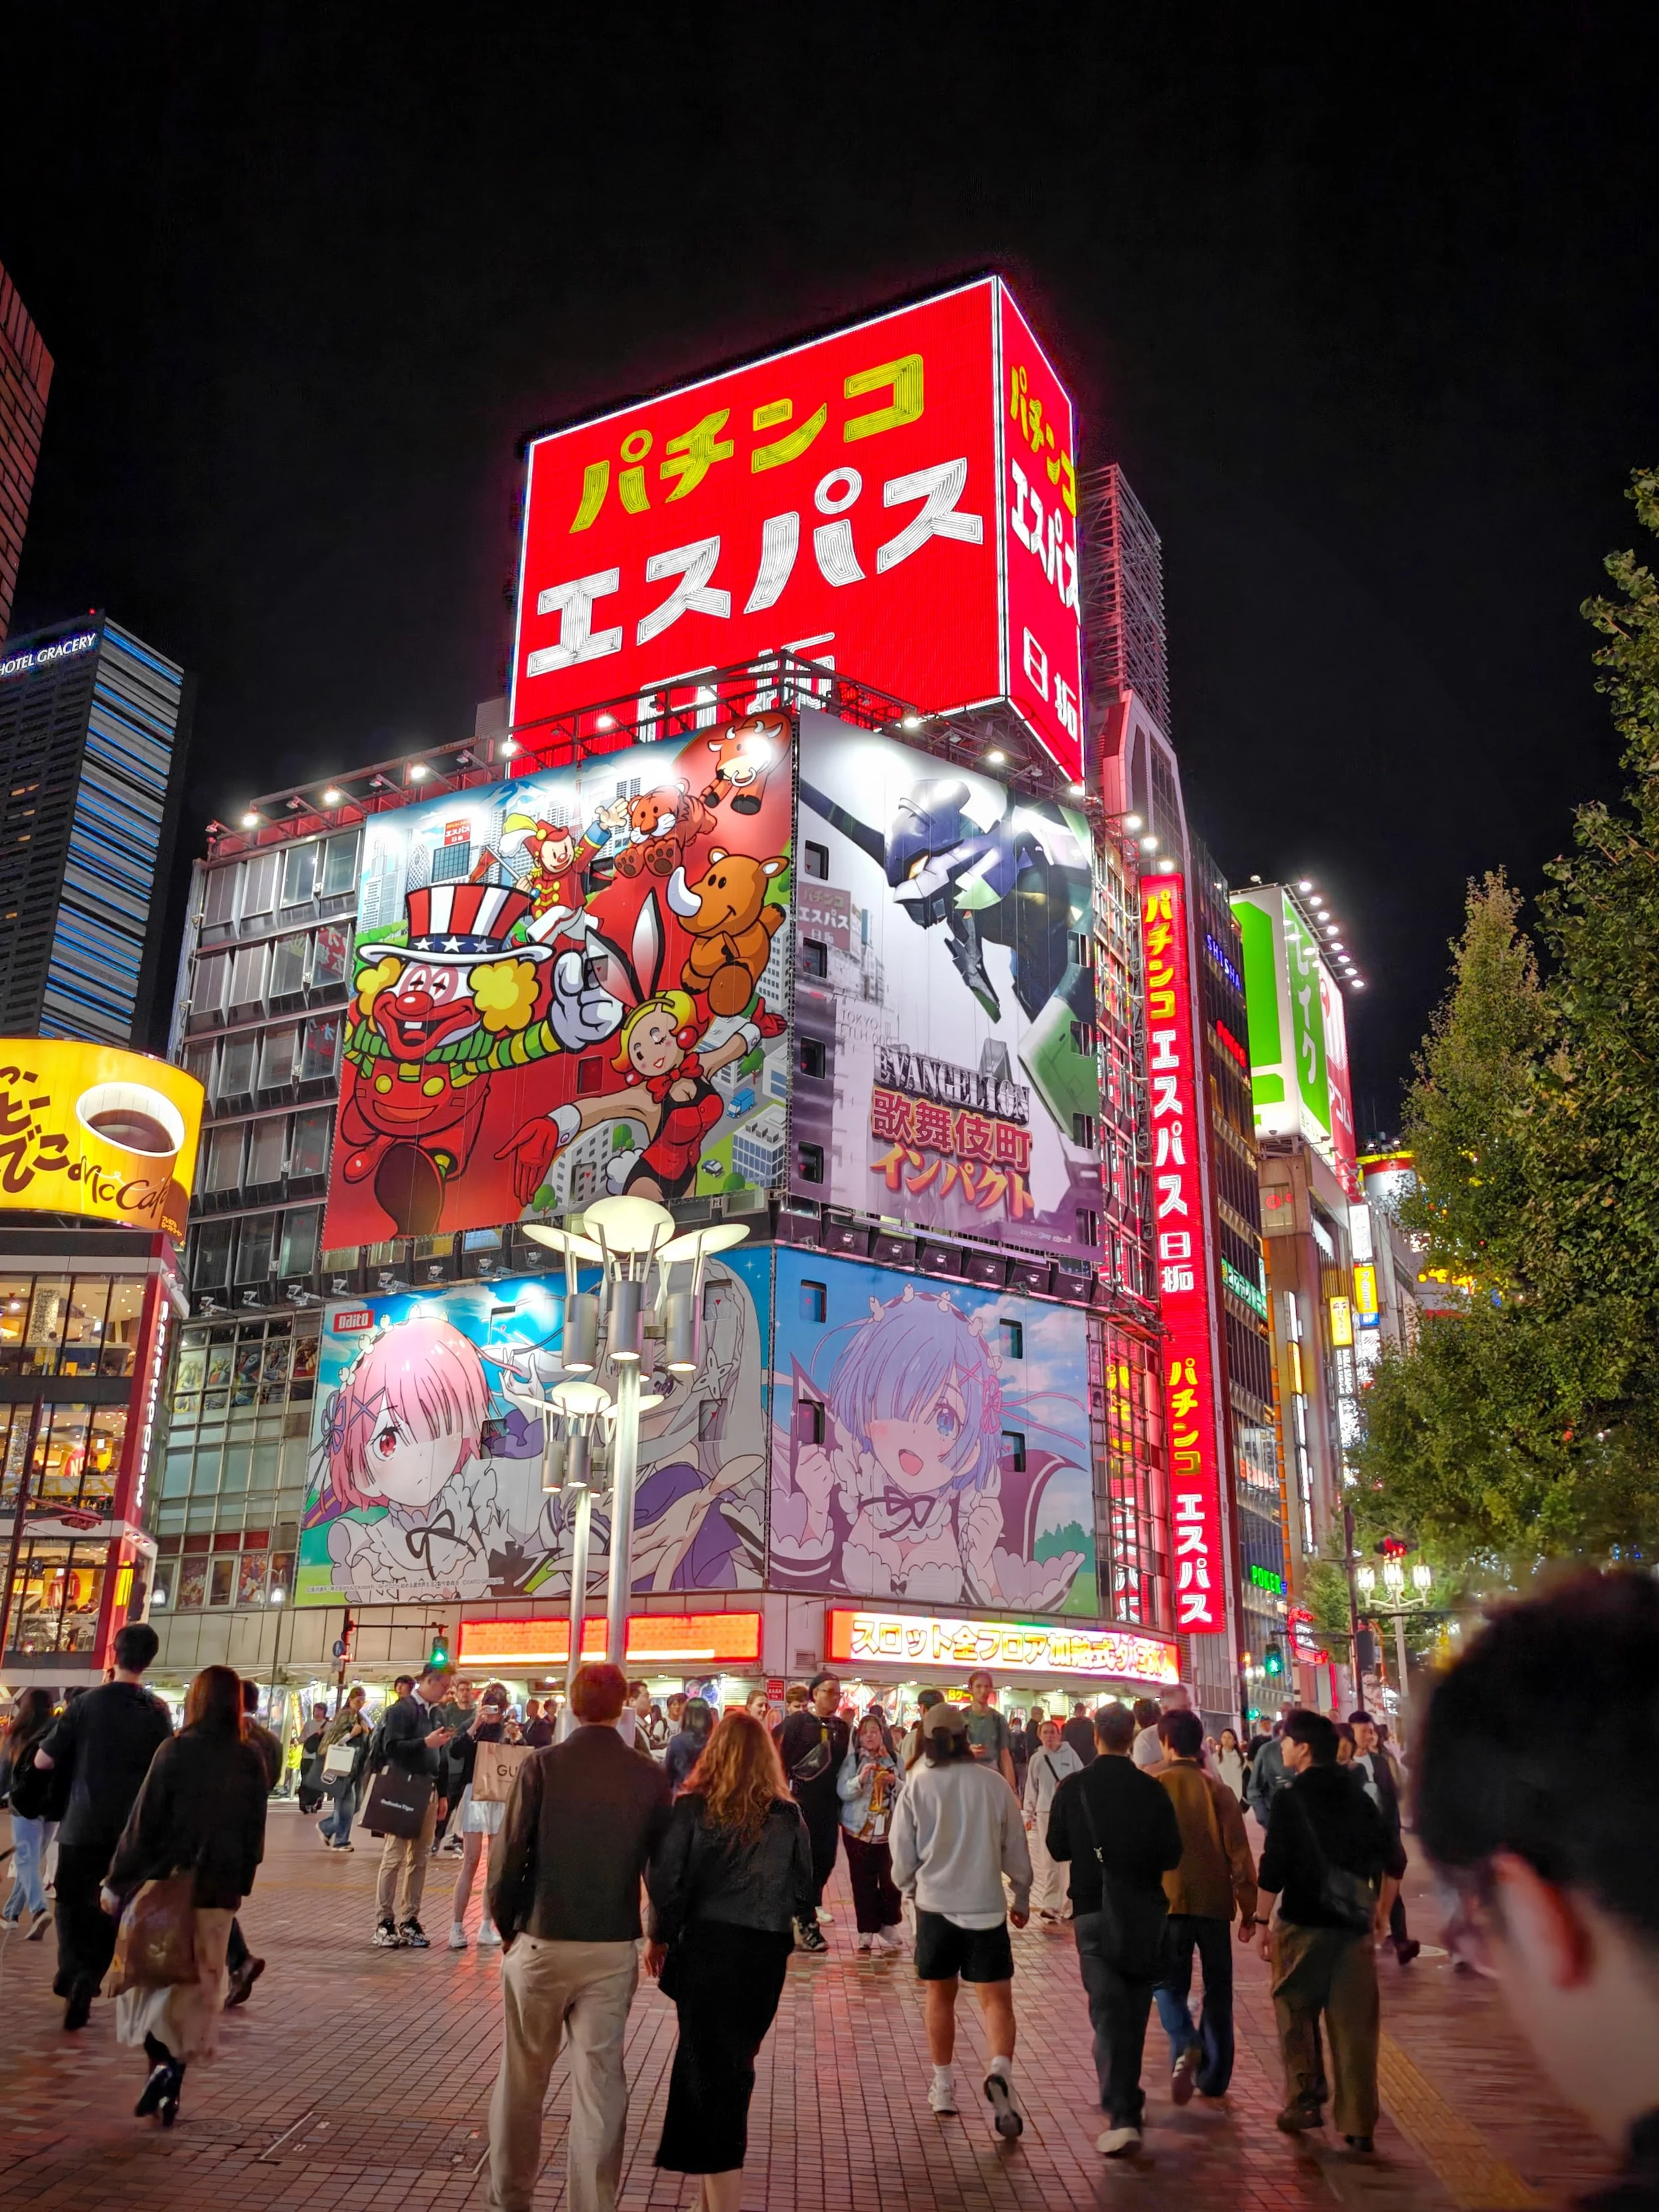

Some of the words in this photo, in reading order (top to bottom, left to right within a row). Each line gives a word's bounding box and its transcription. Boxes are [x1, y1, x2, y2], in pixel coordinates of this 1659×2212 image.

[571, 354, 924, 534] パチンコ
[1010, 365, 1077, 518] パチンコ
[527, 458, 983, 678] エスパス
[1011, 456, 1080, 625] エスパス
[0, 654, 34, 675] HOTEL
[37, 633, 96, 662] GRACERY
[1145, 889, 1175, 1020] パチンコ
[1206, 933, 1242, 992] SHISHA
[872, 1087, 1033, 1173] 歌舞伎町
[873, 1044, 1031, 1123] EVANGELION
[1152, 1030, 1188, 1217] エスパス
[869, 1141, 1035, 1219] インパクト
[1159, 1232, 1194, 1294] 日拓
[1169, 1357, 1201, 1476] パチンコ
[1176, 1493, 1212, 1624] エスパス
